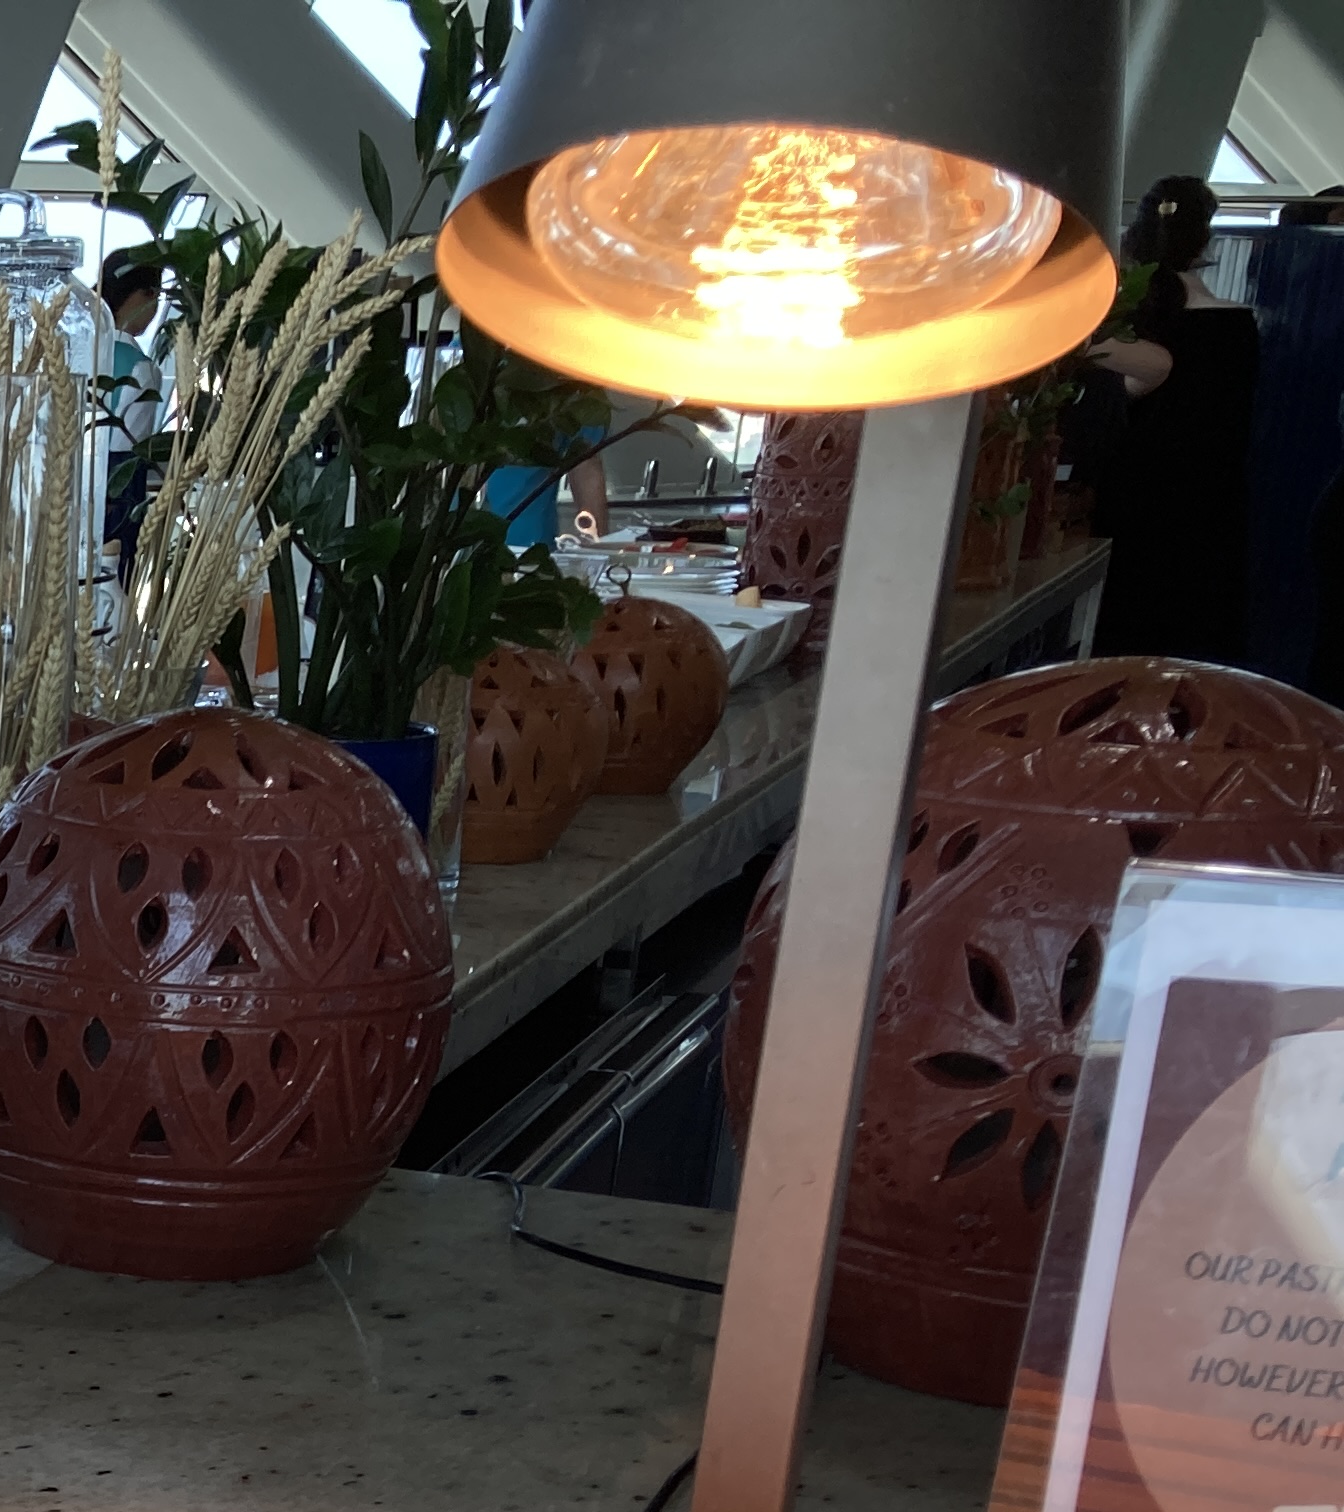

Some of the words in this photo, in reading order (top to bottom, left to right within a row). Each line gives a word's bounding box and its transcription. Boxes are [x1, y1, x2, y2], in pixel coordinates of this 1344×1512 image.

[1184, 1250, 1254, 1285] OUR
[1258, 1257, 1344, 1294] PAST
[1220, 1305, 1272, 1338] DO
[1276, 1314, 1344, 1348] NOT
[1188, 1355, 1344, 1400] HOWEVER
[1250, 1411, 1318, 1446] CAN
